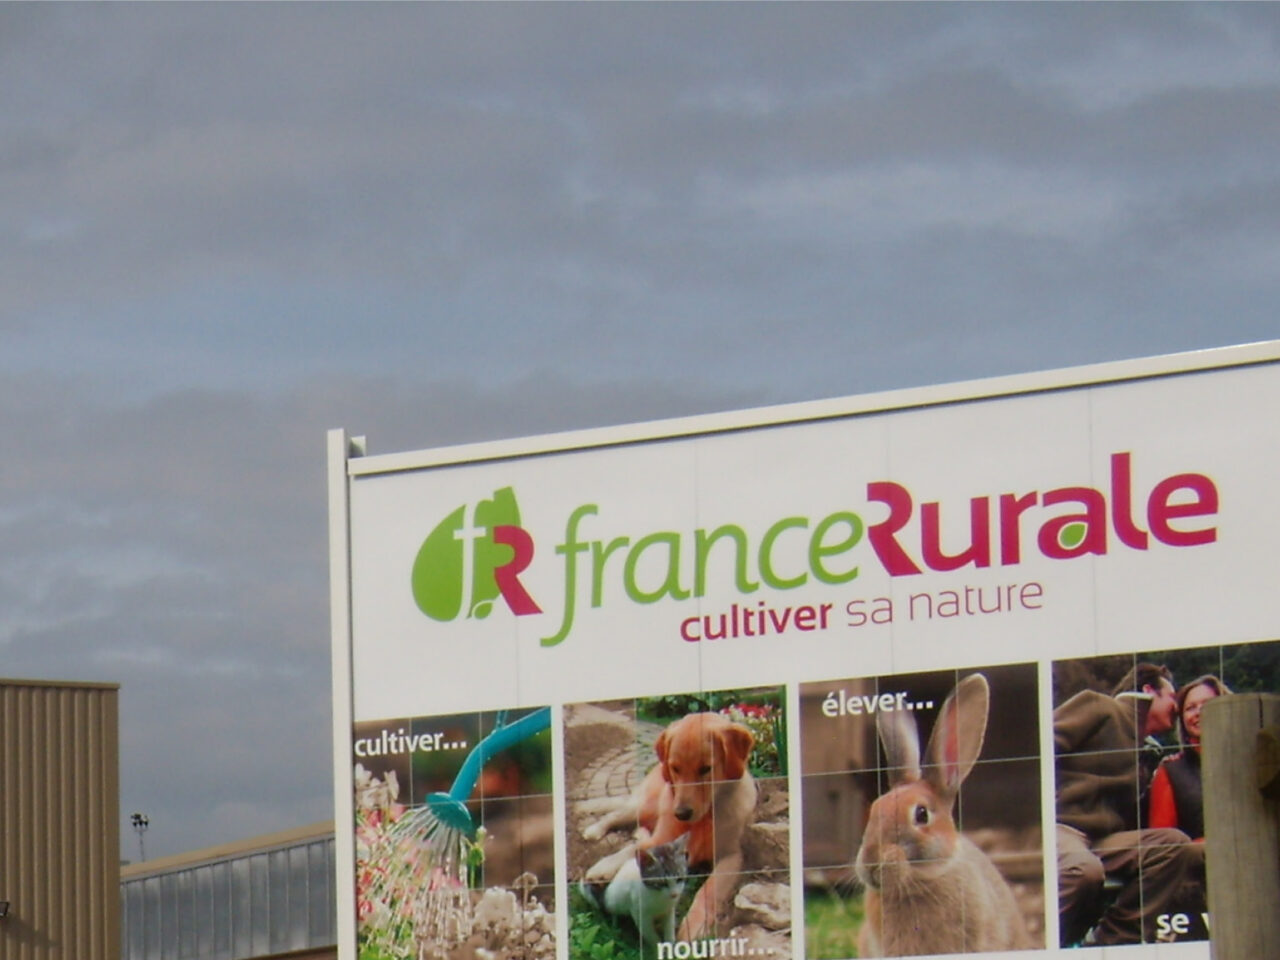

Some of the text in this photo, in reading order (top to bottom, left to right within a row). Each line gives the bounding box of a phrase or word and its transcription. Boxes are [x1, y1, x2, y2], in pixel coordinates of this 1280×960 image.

[680, 581, 1044, 642] cultiver sa nature
[822, 690, 933, 717] élever...
[354, 728, 467, 757] cultiver...
[1156, 913, 1190, 935] se
[657, 931, 773, 960] nourrir...
